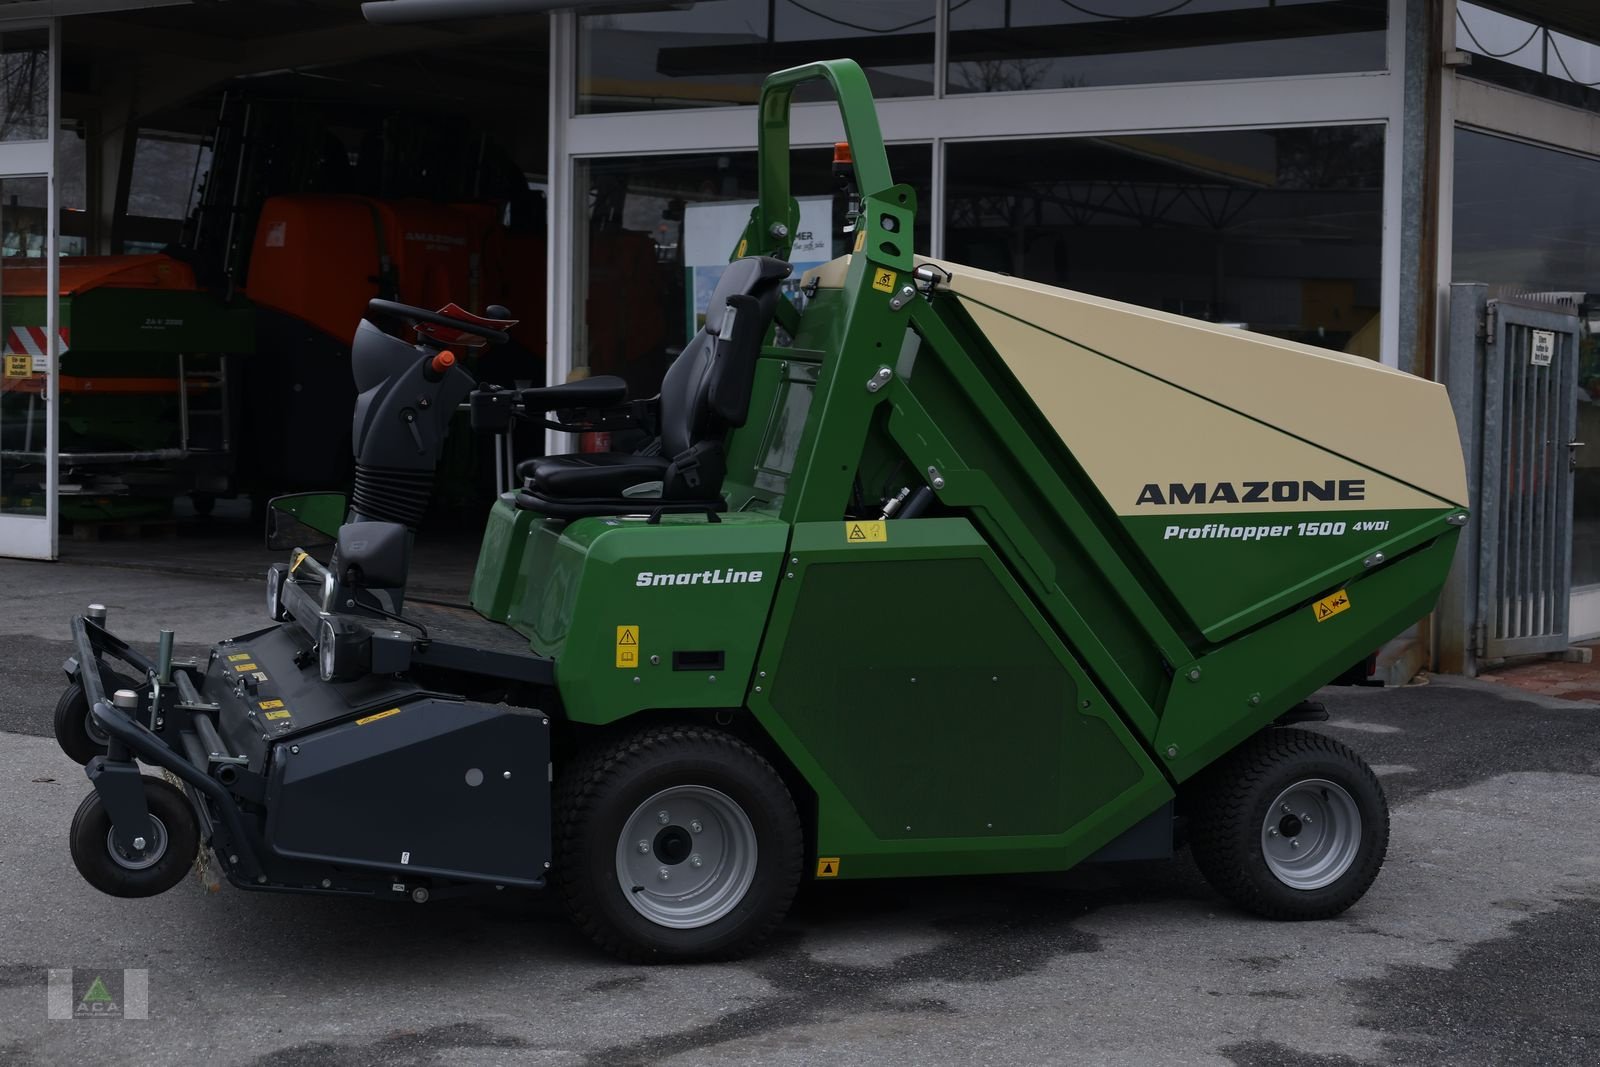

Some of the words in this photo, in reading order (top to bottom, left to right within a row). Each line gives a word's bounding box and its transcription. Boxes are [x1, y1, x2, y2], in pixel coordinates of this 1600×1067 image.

[1136, 480, 1365, 505] AMAZONE
[1163, 523, 1293, 541] Profihopper
[1297, 522, 1346, 536] 1500
[1352, 521, 1389, 532] 4WDi
[636, 568, 763, 586] SmartLine
